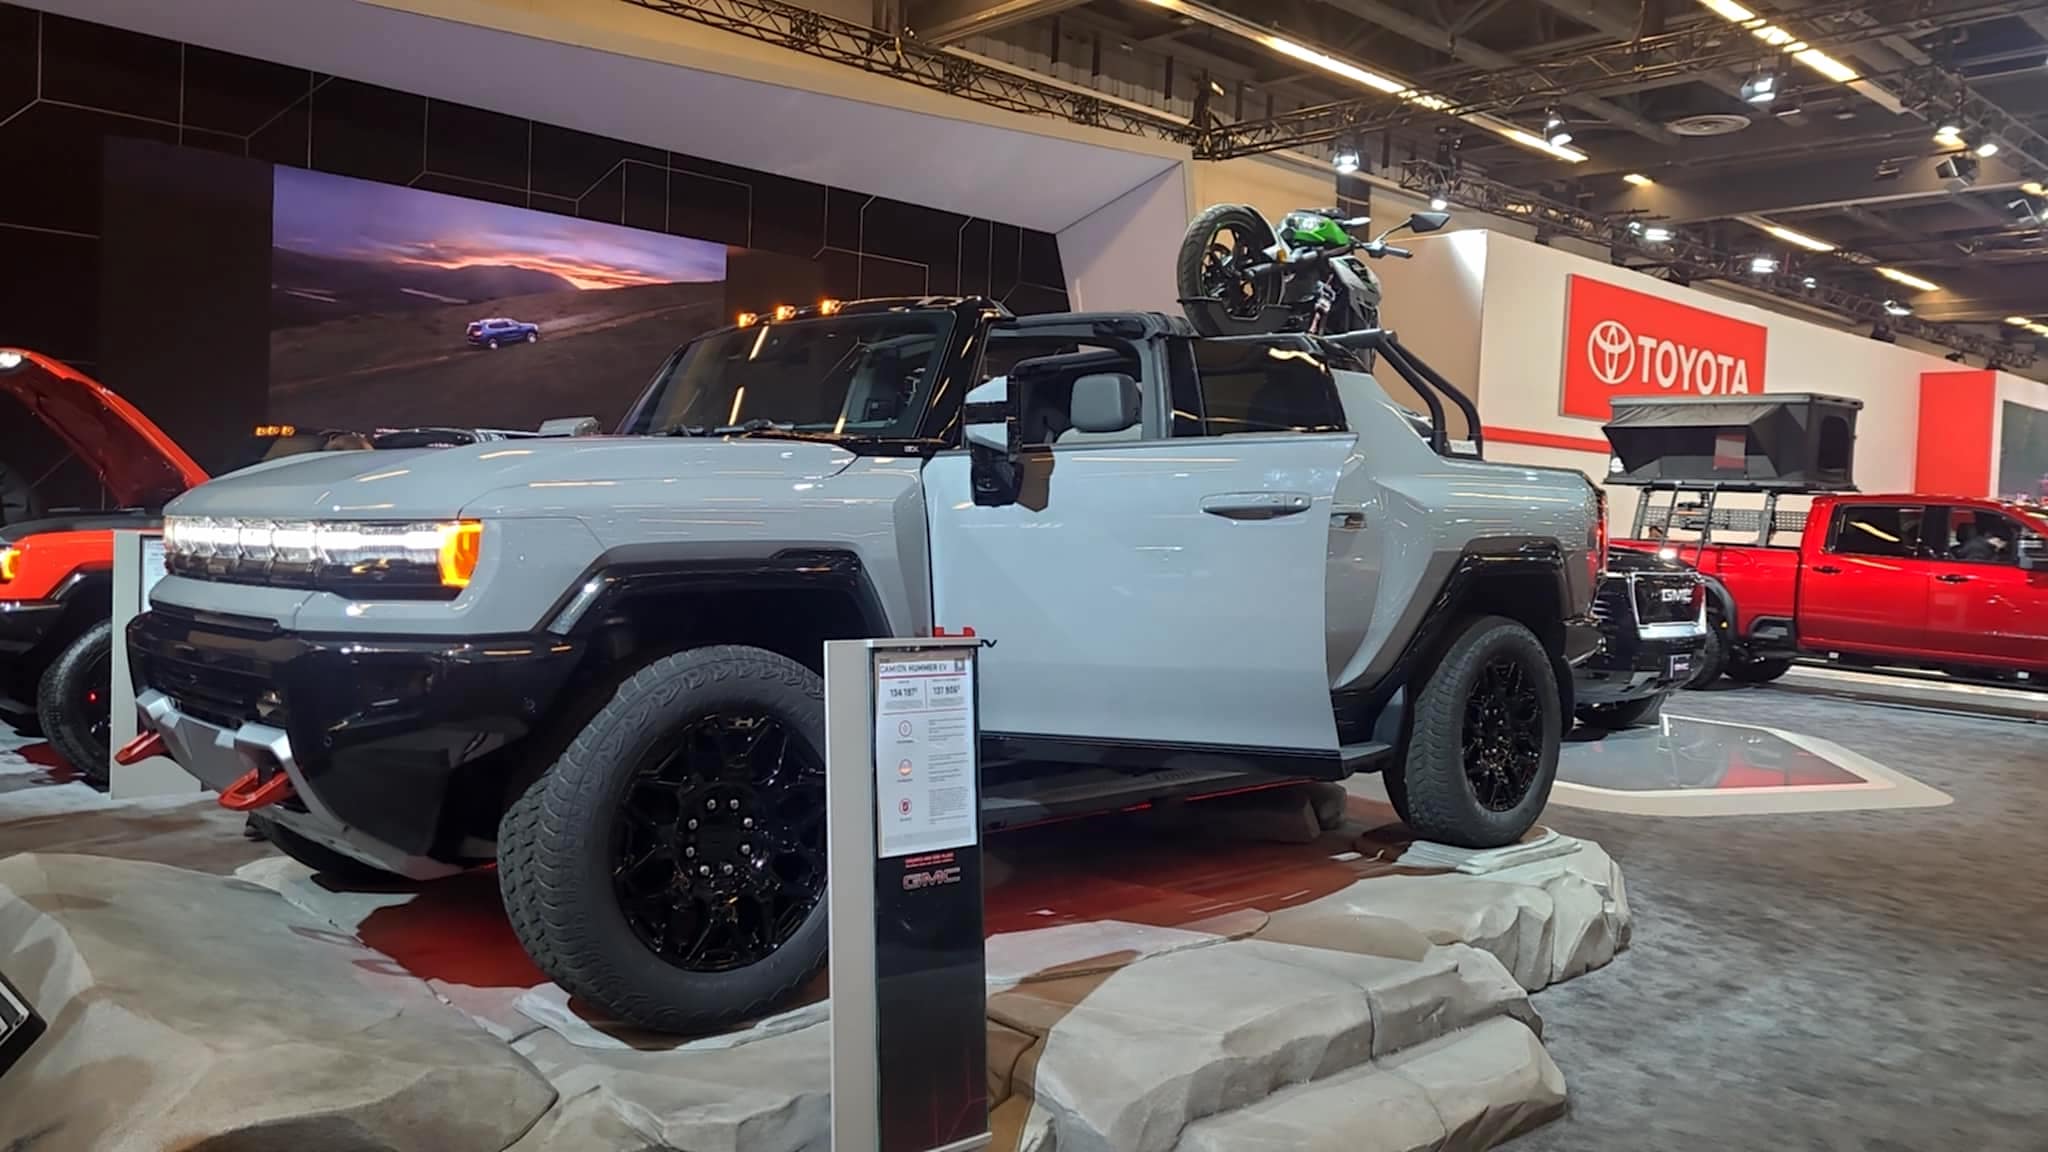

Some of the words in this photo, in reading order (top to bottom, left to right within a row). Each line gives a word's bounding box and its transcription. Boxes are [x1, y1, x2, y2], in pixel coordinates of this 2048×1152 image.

[1638, 335, 1749, 395] TOYOTA
[1661, 588, 1693, 602] GMC
[903, 866, 961, 890] GMC
